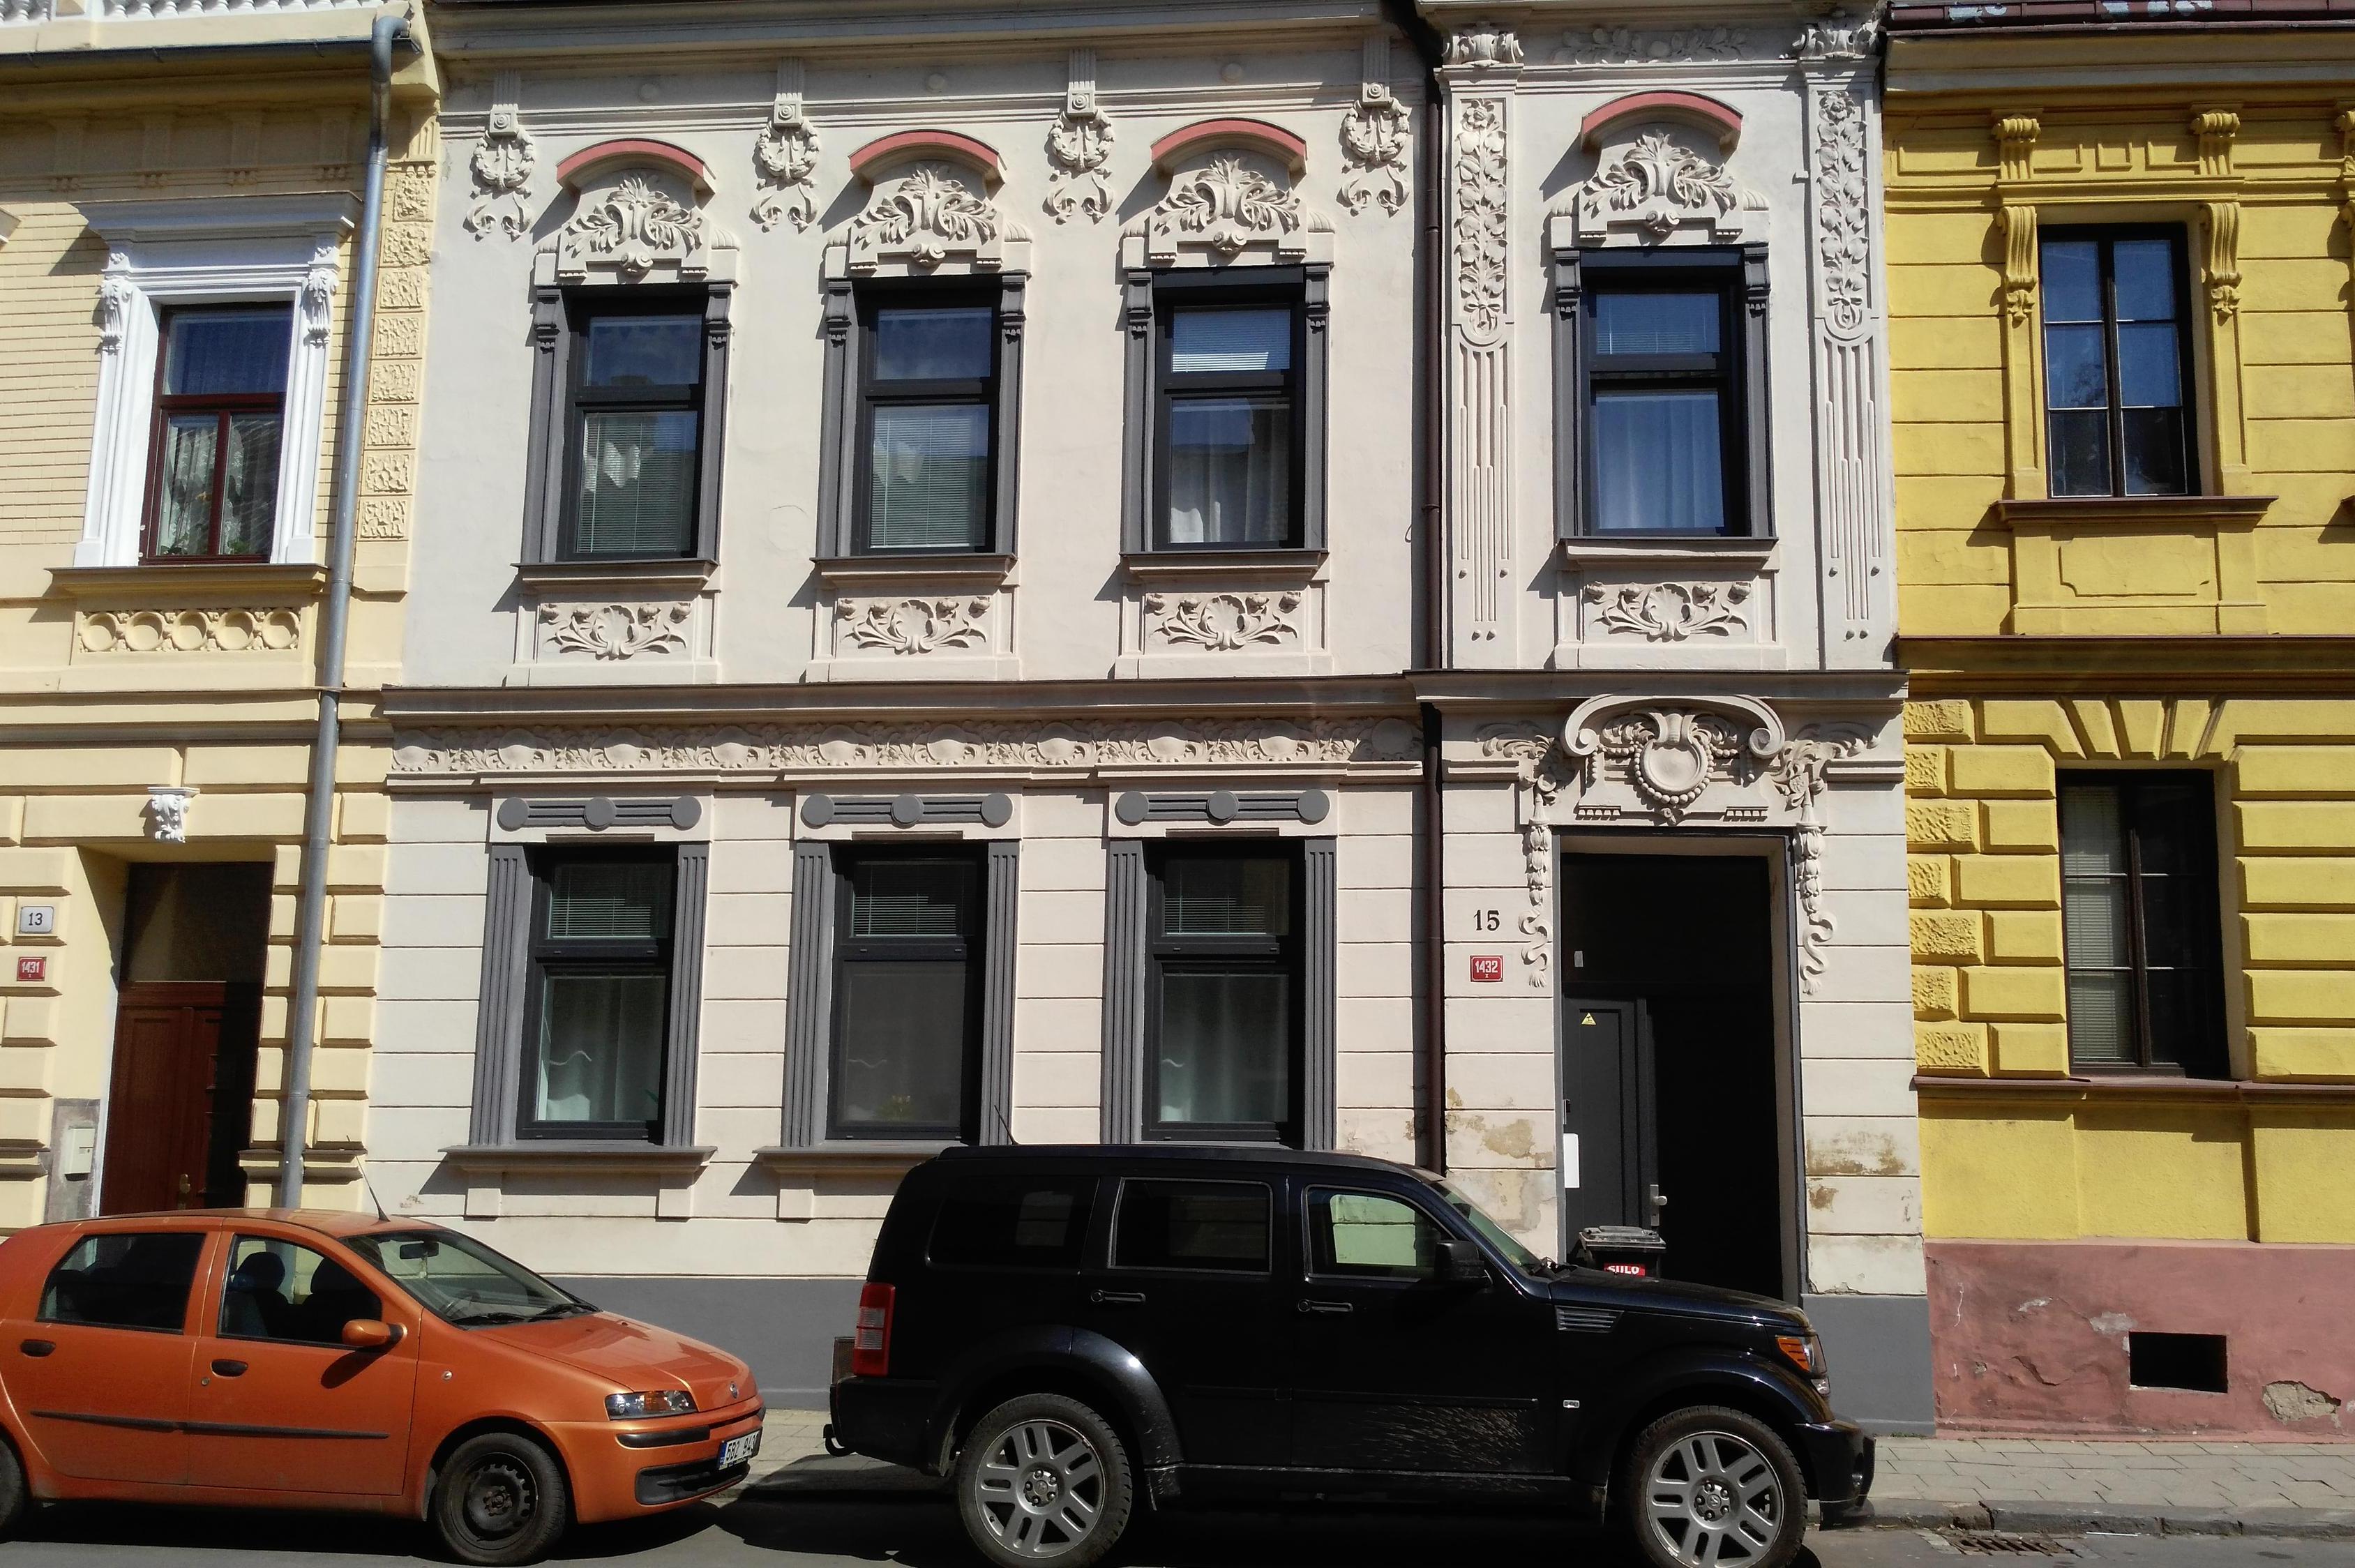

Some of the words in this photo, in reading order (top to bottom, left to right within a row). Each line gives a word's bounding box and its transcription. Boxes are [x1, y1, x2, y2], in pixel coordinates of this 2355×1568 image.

[28, 912, 43, 926] 13
[1473, 909, 1500, 931] 15
[22, 961, 40, 973] 1431
[1475, 960, 1498, 973] 1432
